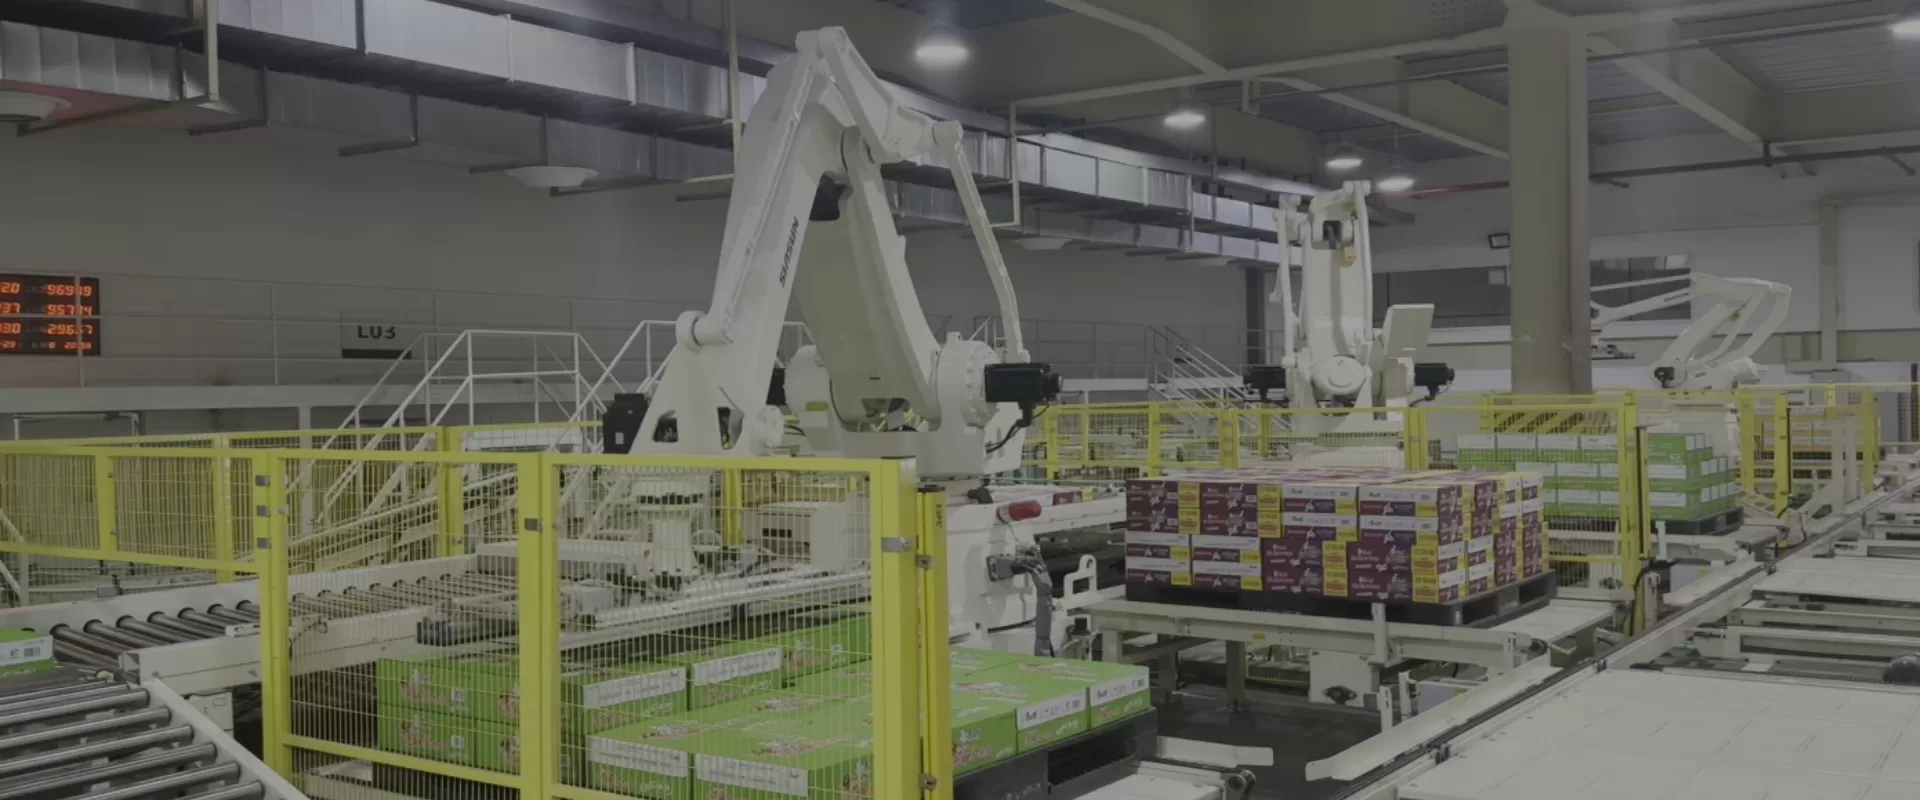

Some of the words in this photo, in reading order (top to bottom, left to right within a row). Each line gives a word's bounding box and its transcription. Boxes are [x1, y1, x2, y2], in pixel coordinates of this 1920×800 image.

[779, 215, 799, 288] SIASUN
[0, 302, 21, 314] 37
[0, 322, 21, 334] 30
